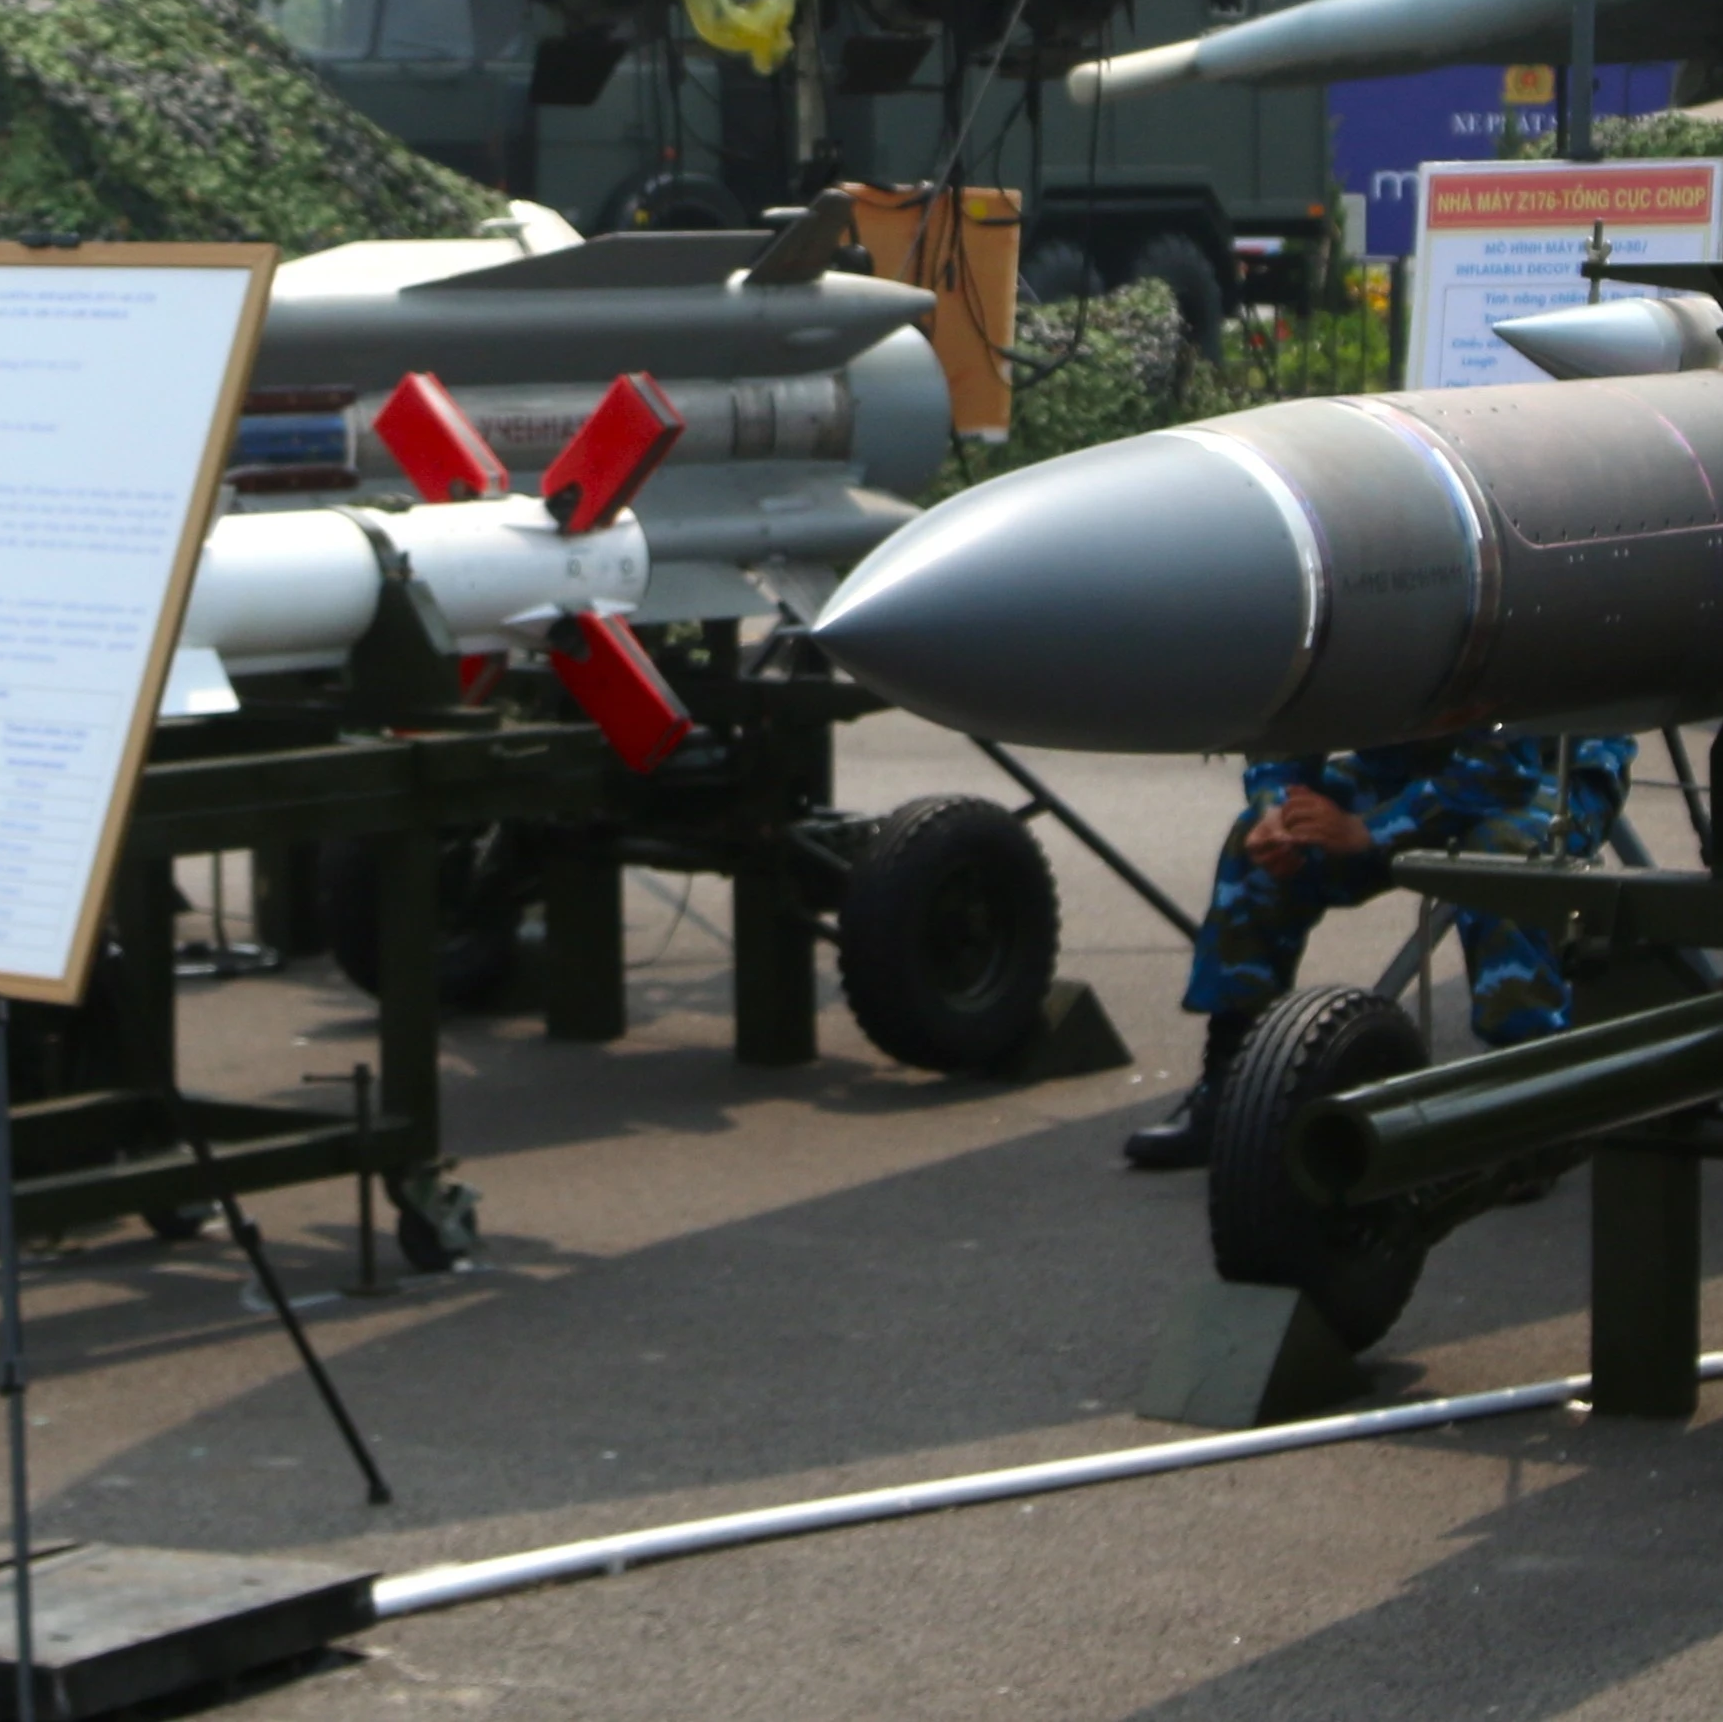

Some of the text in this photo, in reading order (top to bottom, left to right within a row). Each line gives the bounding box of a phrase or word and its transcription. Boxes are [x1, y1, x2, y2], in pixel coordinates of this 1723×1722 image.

[1437, 189, 1472, 212] NHÀ
[1477, 186, 1516, 211] MÁY
[1615, 187, 1651, 214] CỤC
[1656, 186, 1708, 207] CNQP
